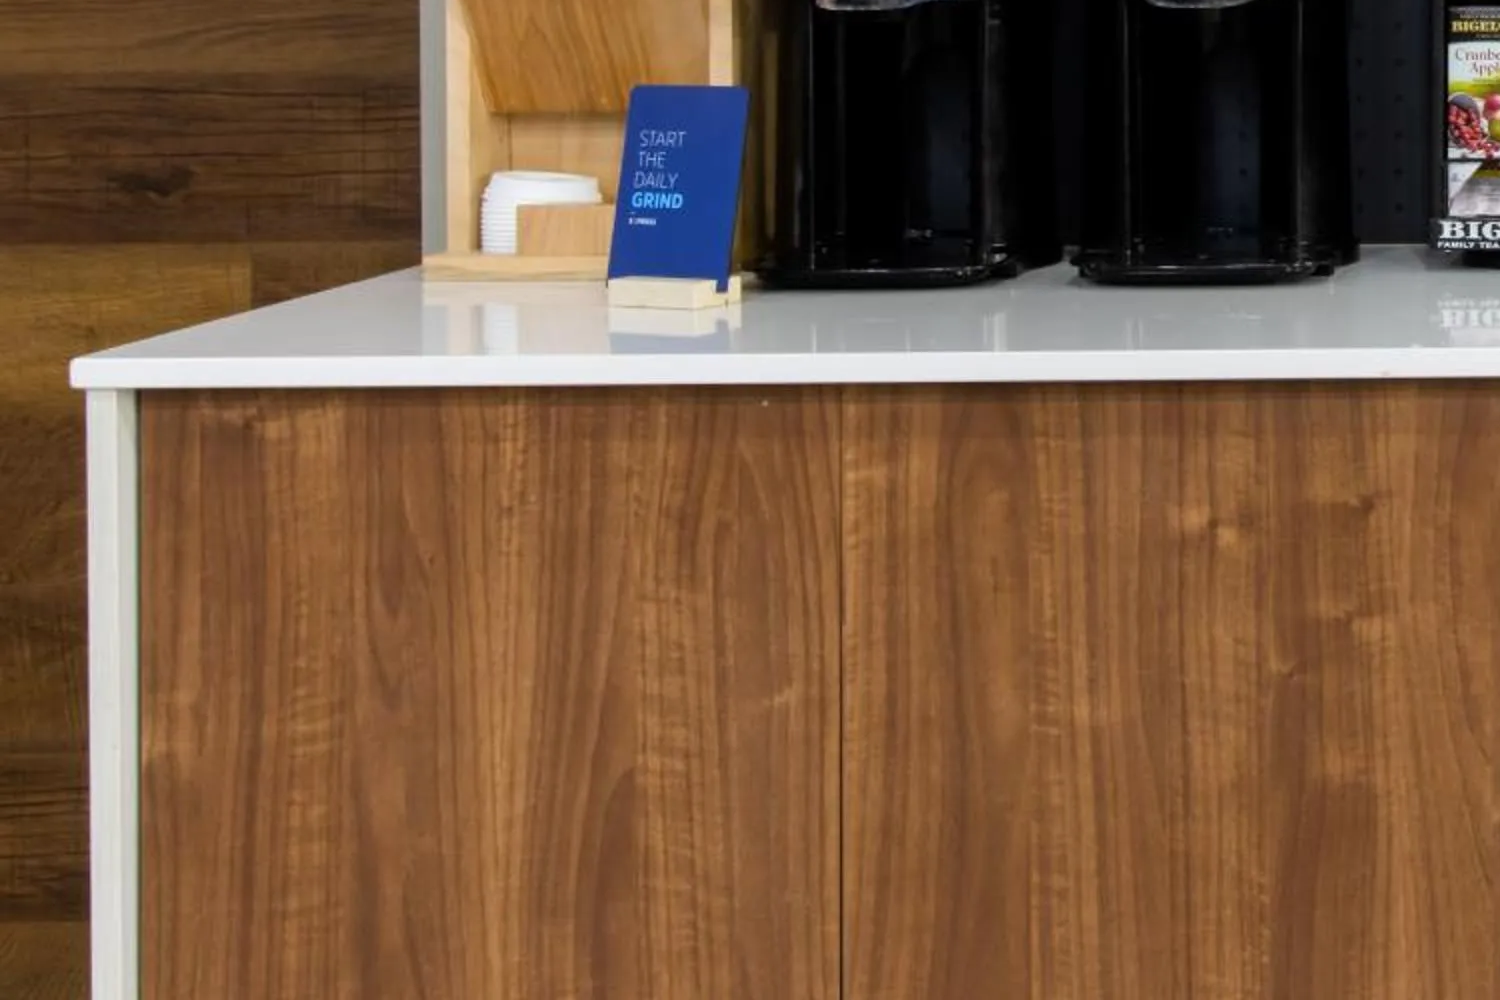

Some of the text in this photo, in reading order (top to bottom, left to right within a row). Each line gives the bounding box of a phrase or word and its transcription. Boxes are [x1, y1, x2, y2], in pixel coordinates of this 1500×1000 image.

[639, 130, 687, 148] START
[637, 151, 667, 169] THE
[633, 171, 679, 190] DAILY
[631, 192, 684, 209] GRIND
[1437, 241, 1476, 250] FAMILY
[1480, 242, 1500, 250] TEA
